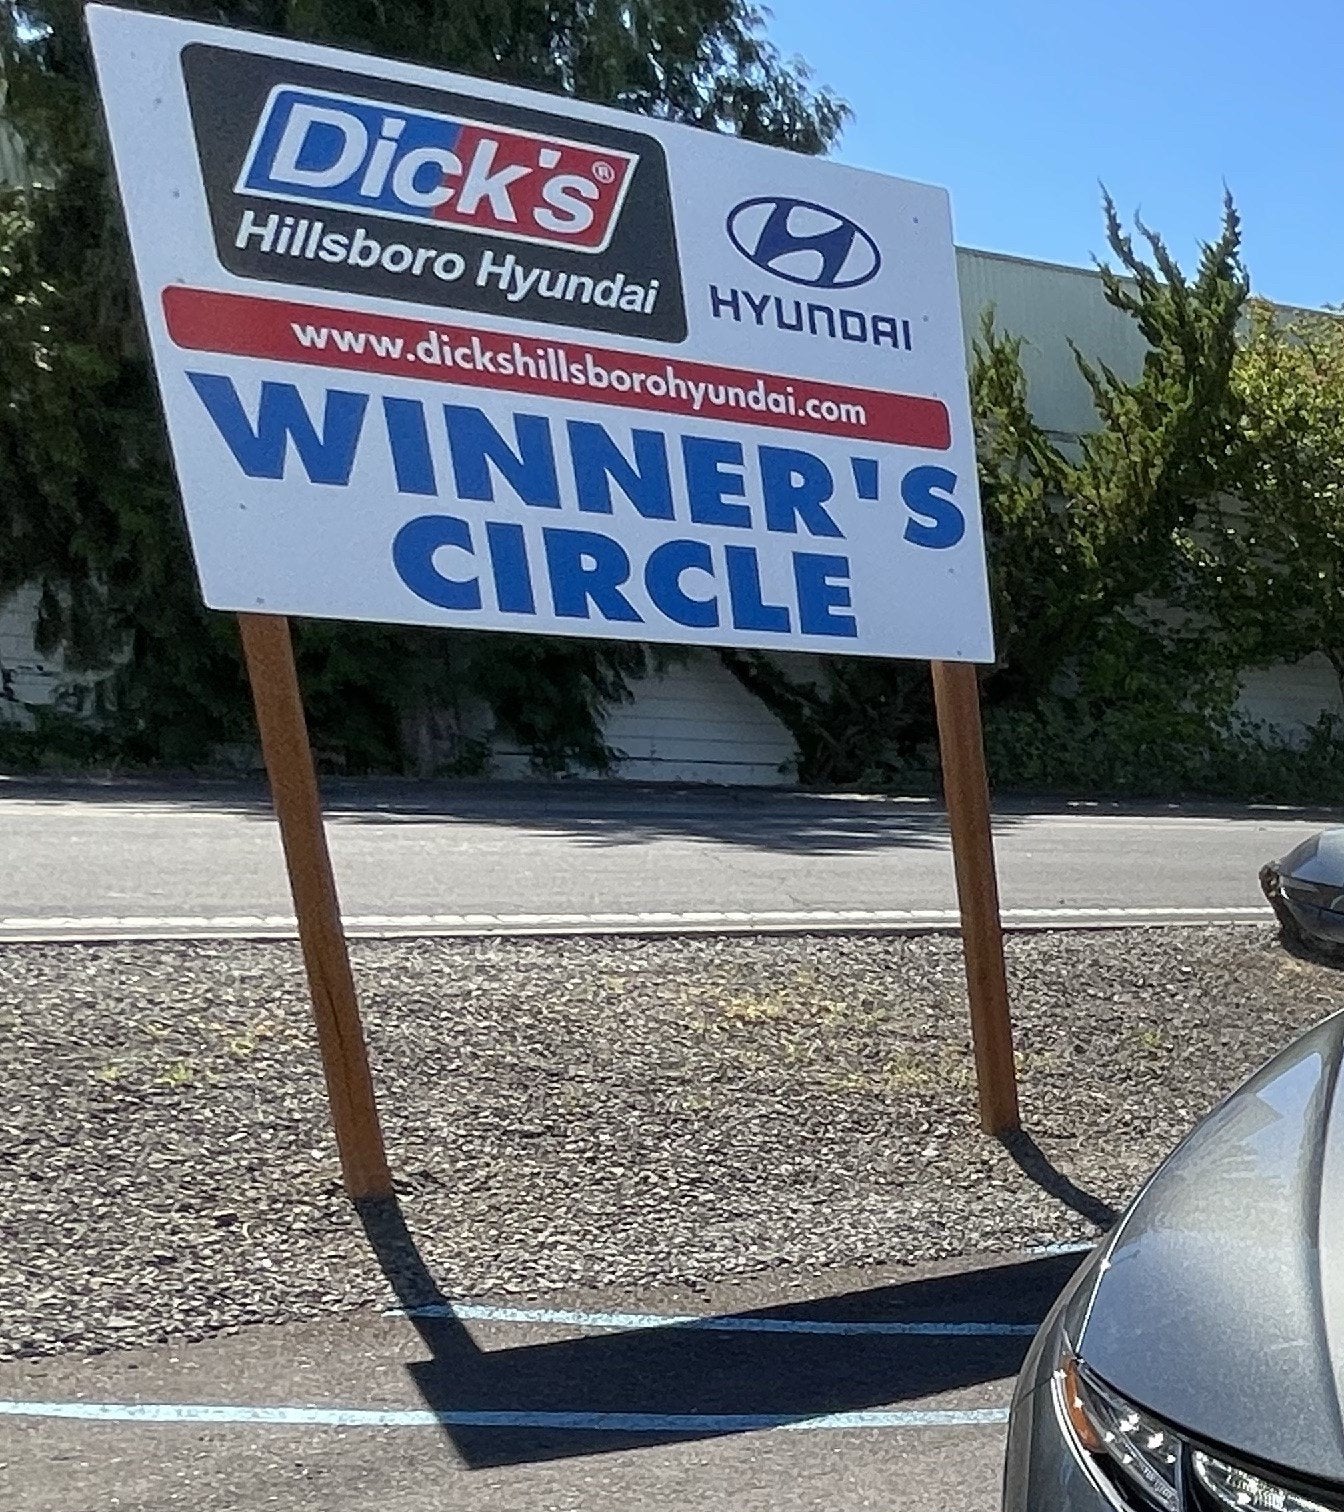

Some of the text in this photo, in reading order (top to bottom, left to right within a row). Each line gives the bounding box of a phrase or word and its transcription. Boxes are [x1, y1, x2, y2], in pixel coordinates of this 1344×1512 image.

[235, 209, 661, 315] Hillsboro Hyundai
[710, 284, 912, 350] HYUNDAI
[290, 322, 867, 426] www.dickshillsborohyundai.com
[185, 370, 966, 549] WINNER'S
[392, 514, 859, 638] CIRCLE
